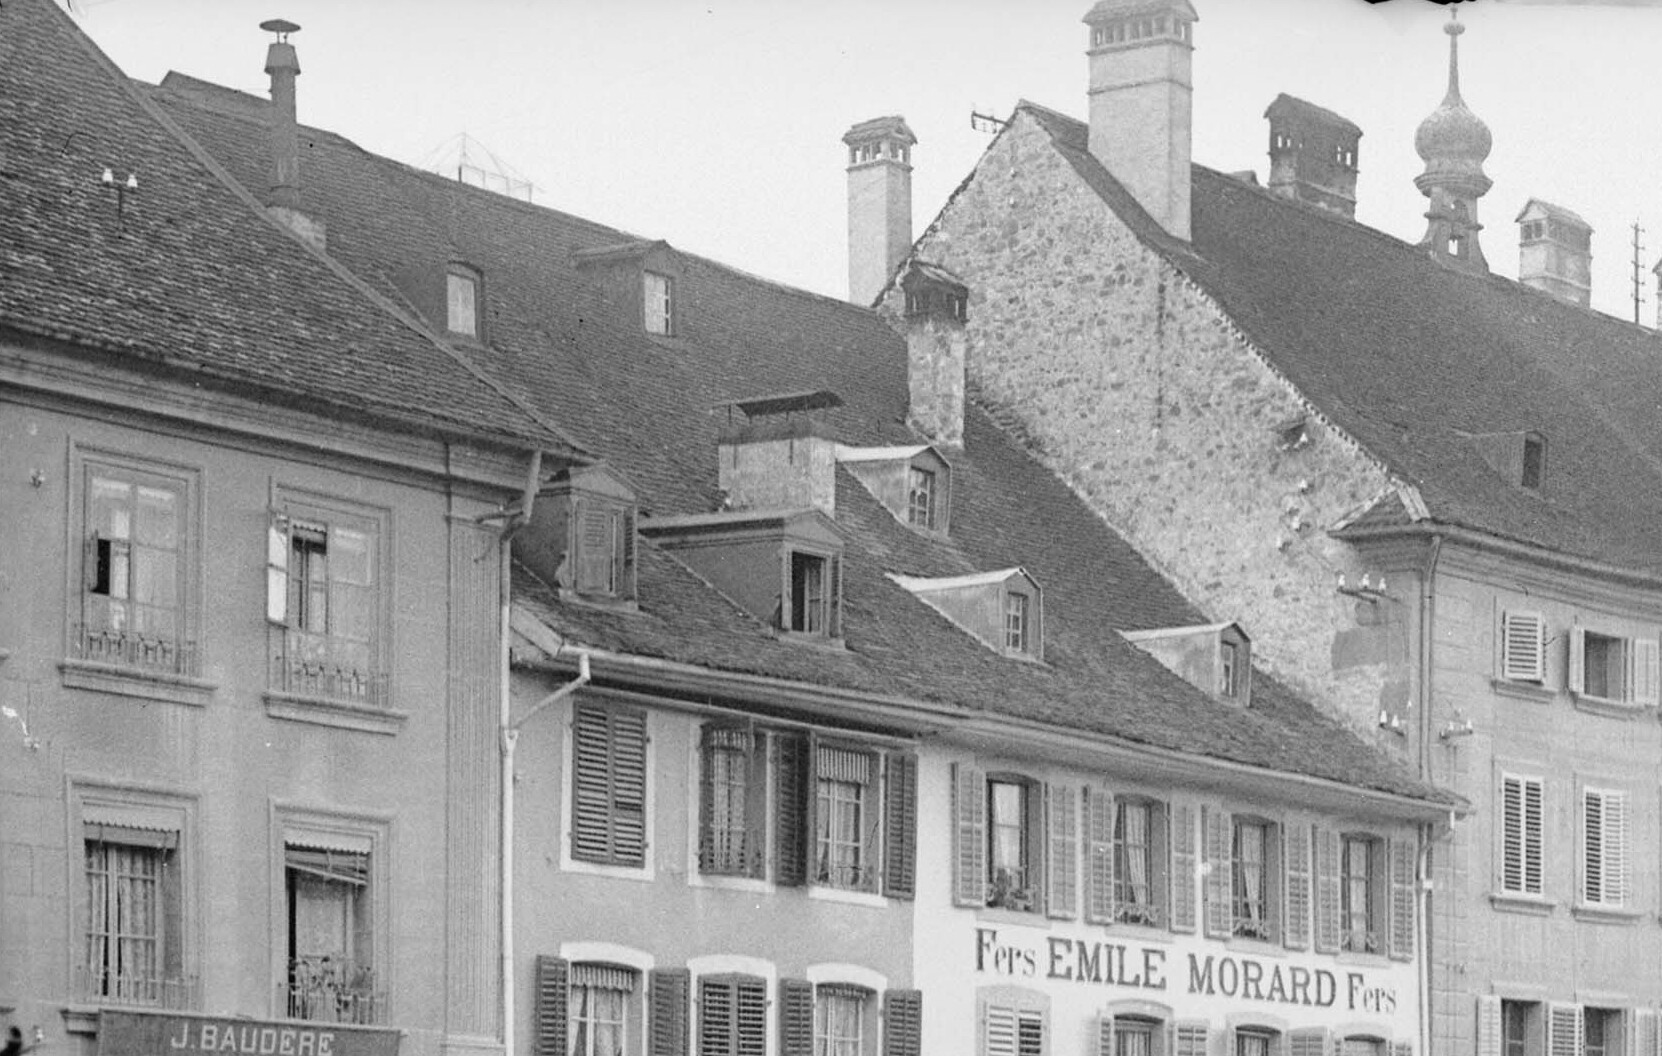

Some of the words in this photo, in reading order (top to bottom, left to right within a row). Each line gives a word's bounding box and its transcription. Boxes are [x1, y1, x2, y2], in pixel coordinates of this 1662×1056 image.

[975, 928, 1036, 976] Fers
[1046, 937, 1168, 990] EMILE
[1187, 953, 1337, 1008] MORARD
[1346, 973, 1397, 1014] Fers
